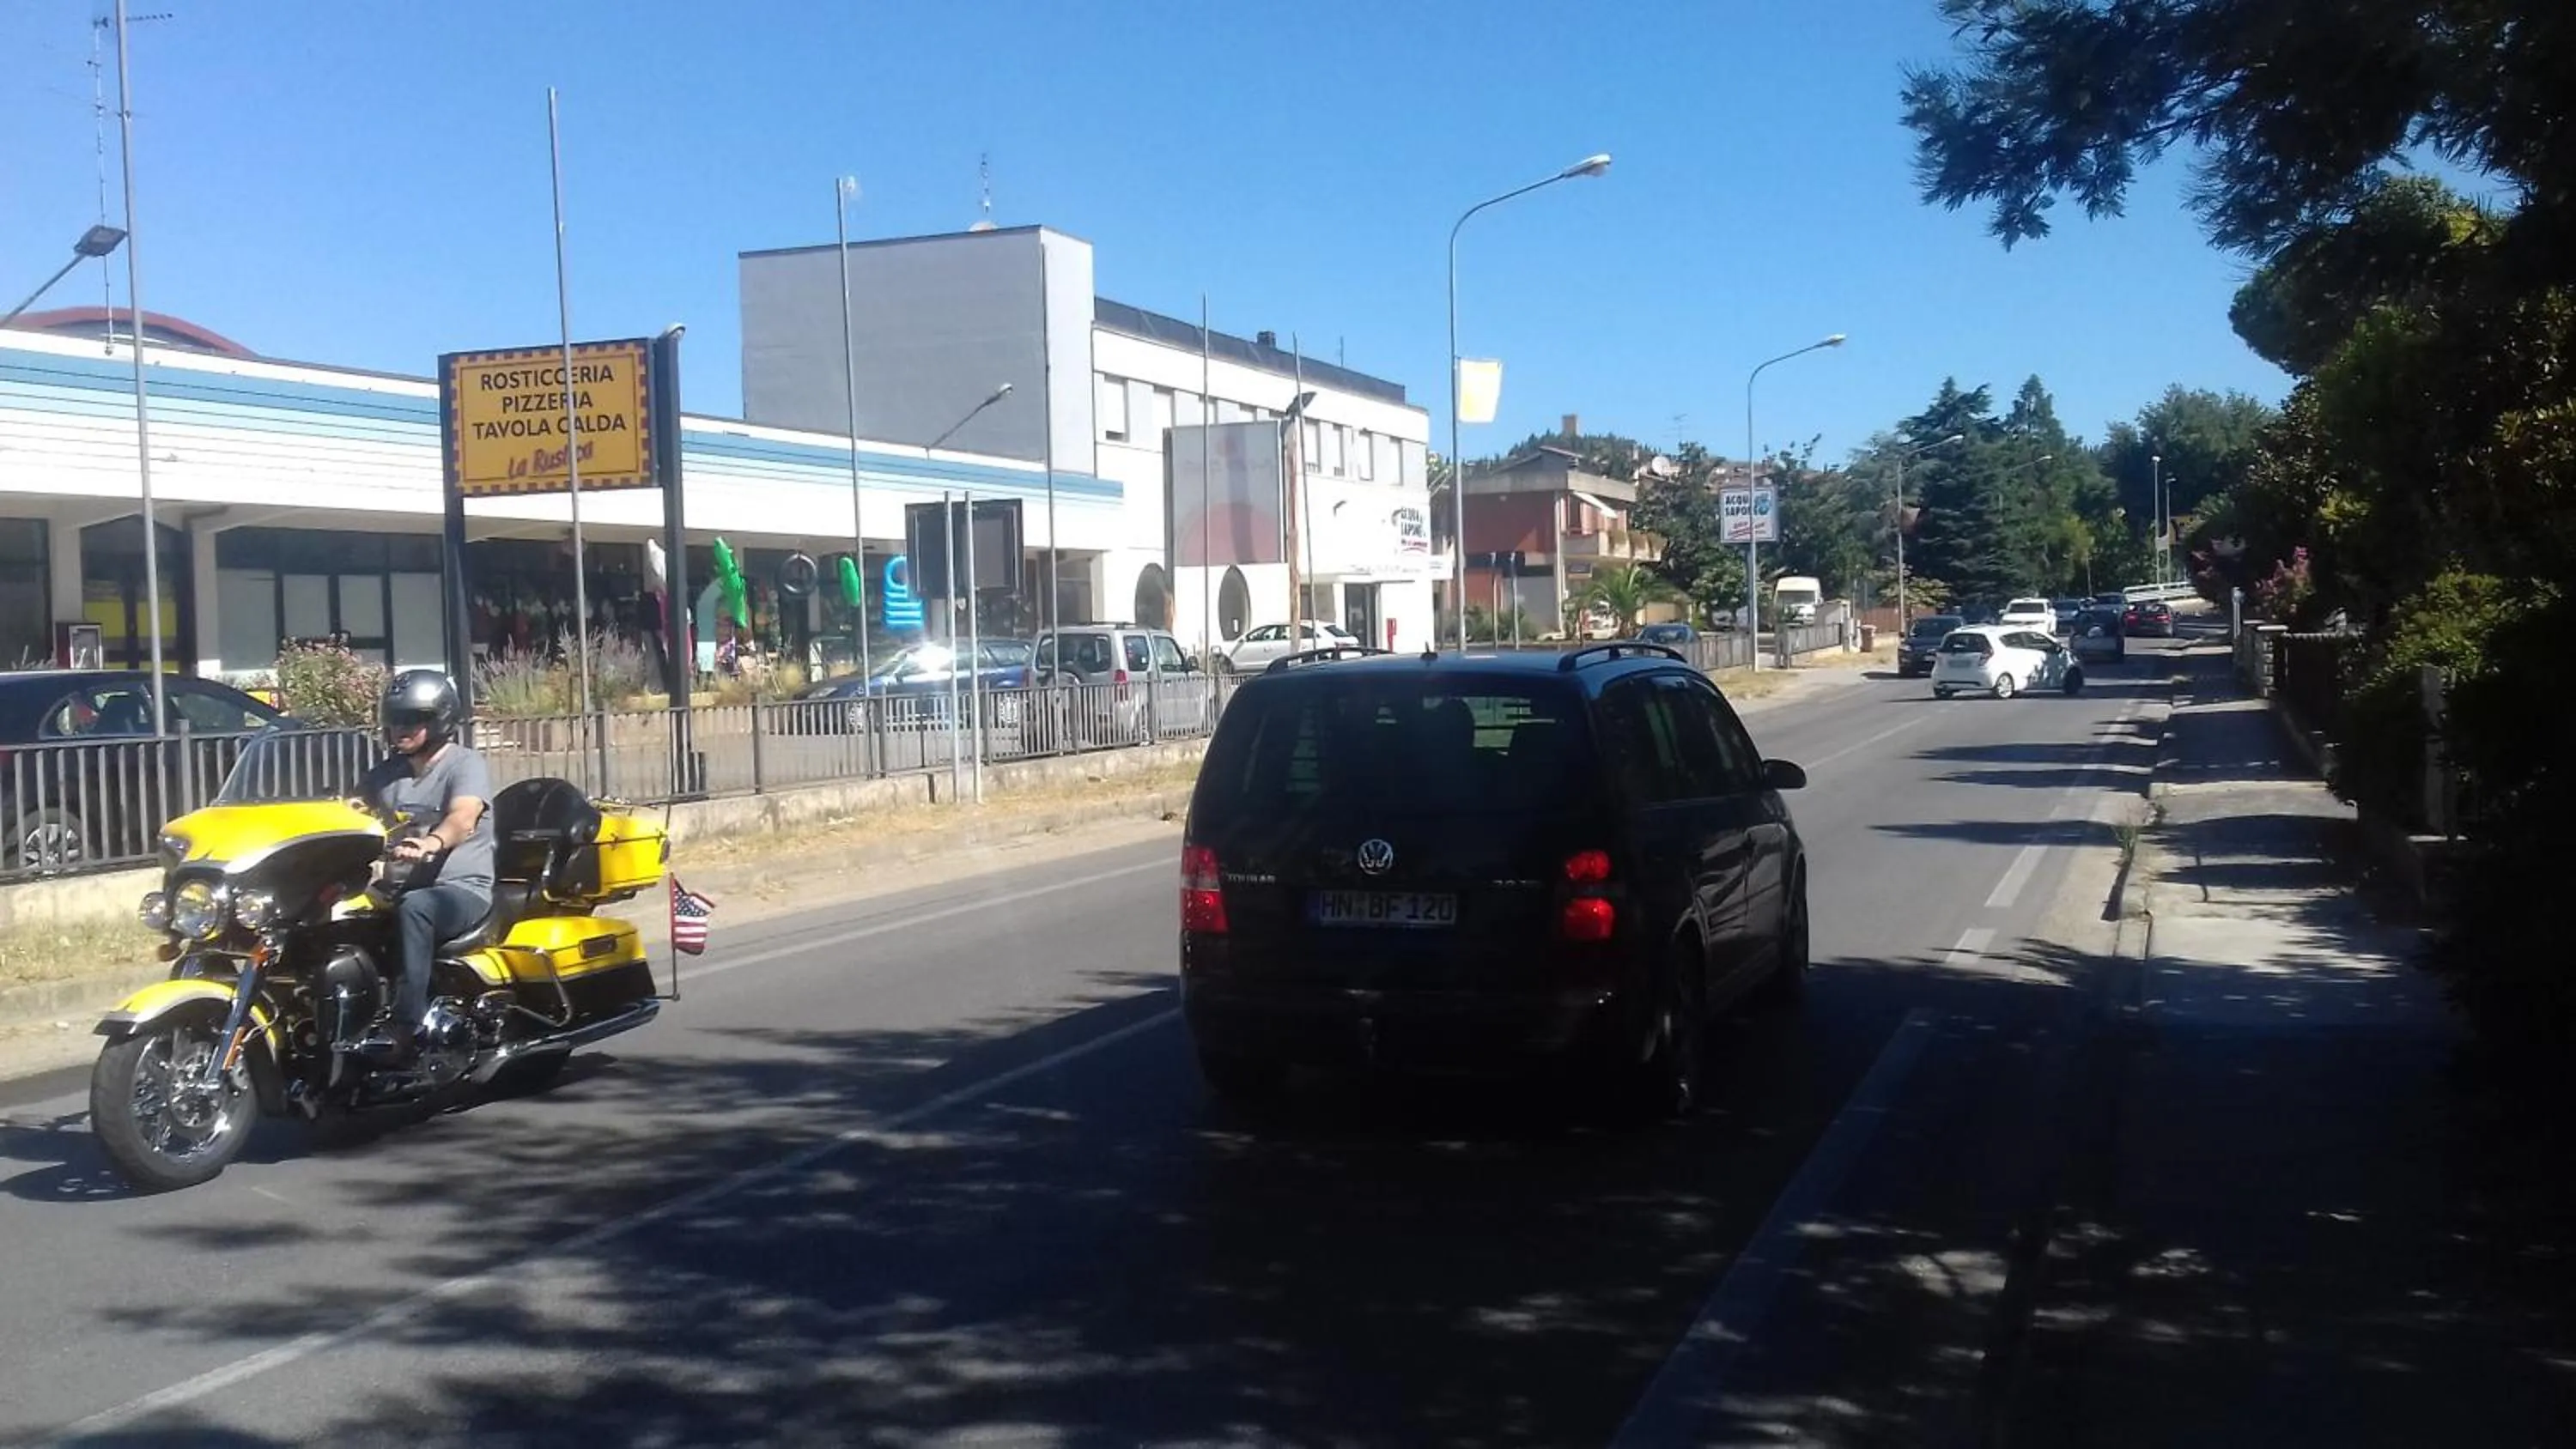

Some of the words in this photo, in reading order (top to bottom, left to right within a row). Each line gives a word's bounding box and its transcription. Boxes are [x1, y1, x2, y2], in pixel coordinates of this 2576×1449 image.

[482, 365, 614, 391] ROSTICCERIA
[502, 391, 593, 413] PIZZERIA
[472, 419, 551, 440] TAVOLA
[557, 413, 627, 433] CALDA
[508, 457, 527, 480] La
[533, 440, 593, 472] Rustca
[1725, 494, 1753, 506] ACQU
[1321, 894, 1352, 918] HN
[1369, 894, 1401, 919] BF
[1406, 895, 1453, 920] 120
